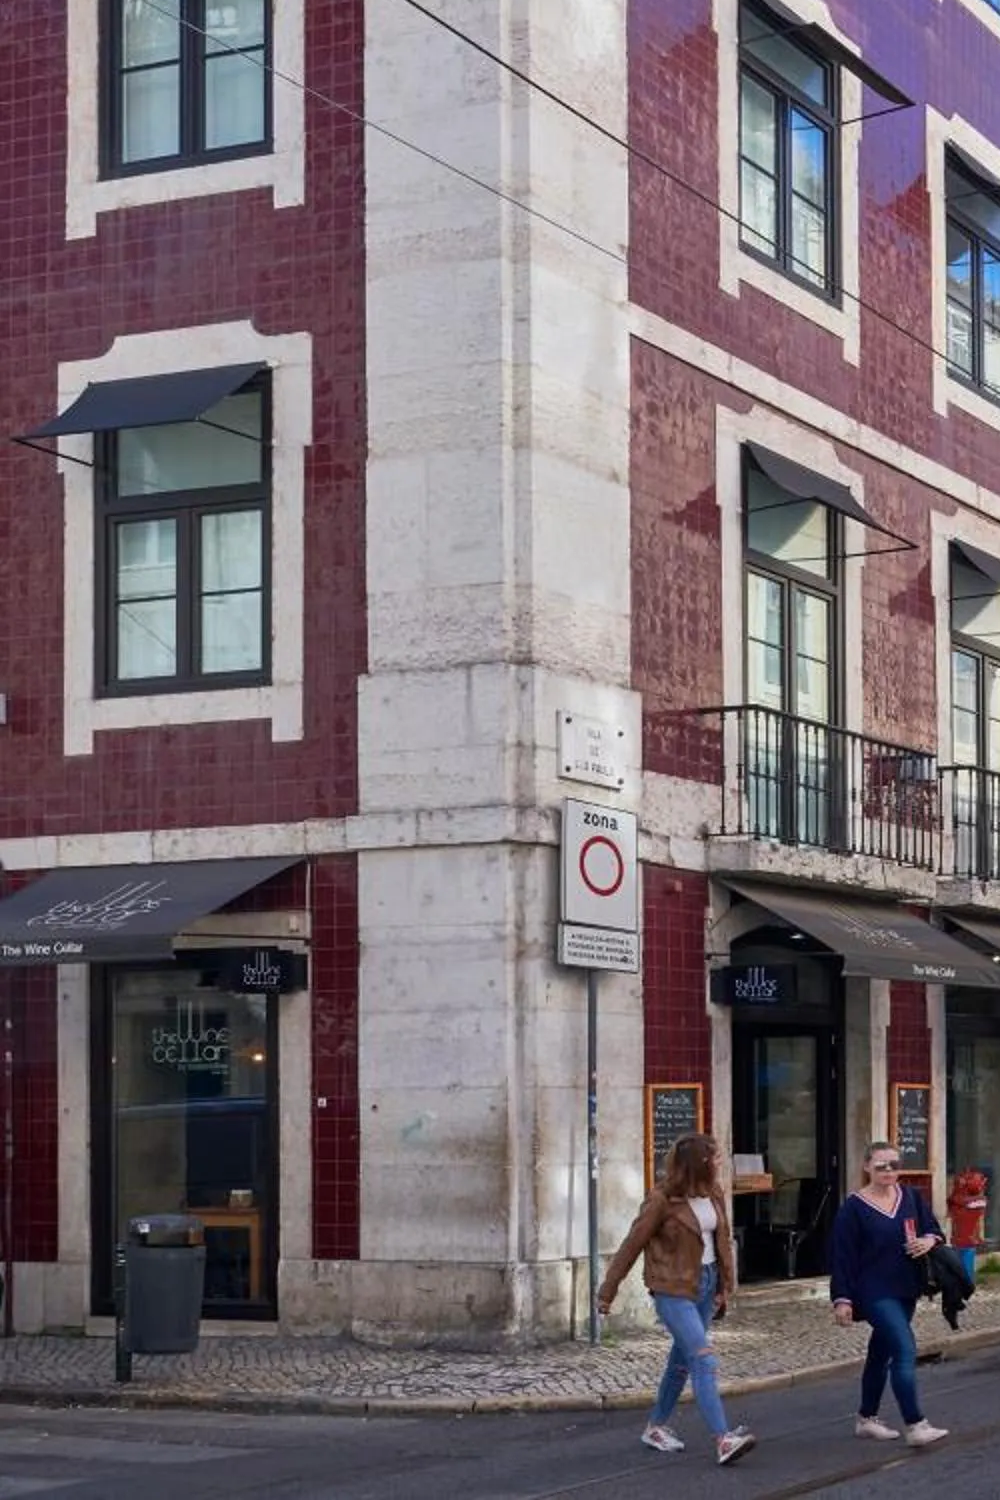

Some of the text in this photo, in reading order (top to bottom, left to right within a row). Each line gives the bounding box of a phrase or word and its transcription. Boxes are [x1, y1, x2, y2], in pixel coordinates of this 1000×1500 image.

[583, 811, 618, 831] zona
[2, 945, 22, 957] The
[24, 943, 50, 957] Wine
